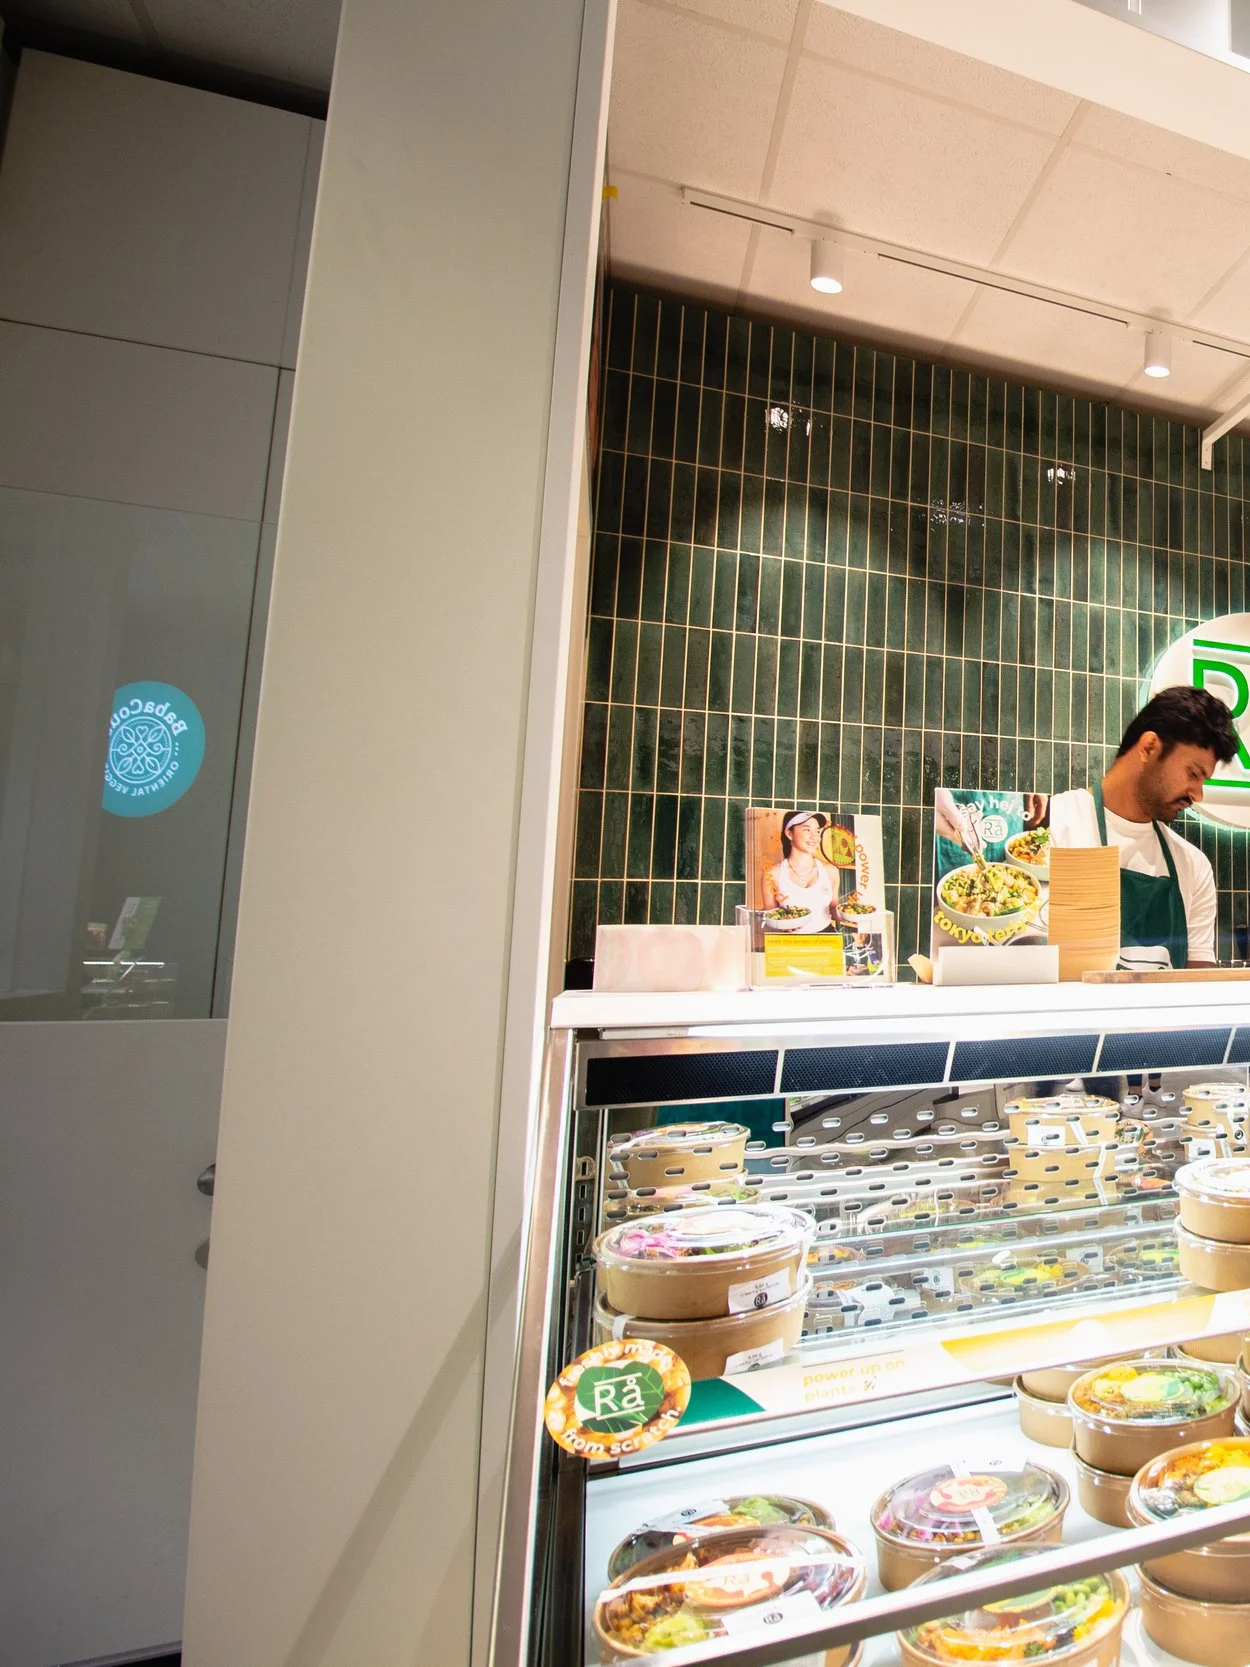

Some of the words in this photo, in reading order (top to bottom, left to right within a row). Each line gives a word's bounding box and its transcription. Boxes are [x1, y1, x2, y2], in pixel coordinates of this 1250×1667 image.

[933, 910, 983, 945] tokyo
[803, 1367, 855, 1388] power
[860, 1363, 881, 1377] up
[593, 1376, 645, 1418] Rå
[560, 1428, 606, 1454] from
